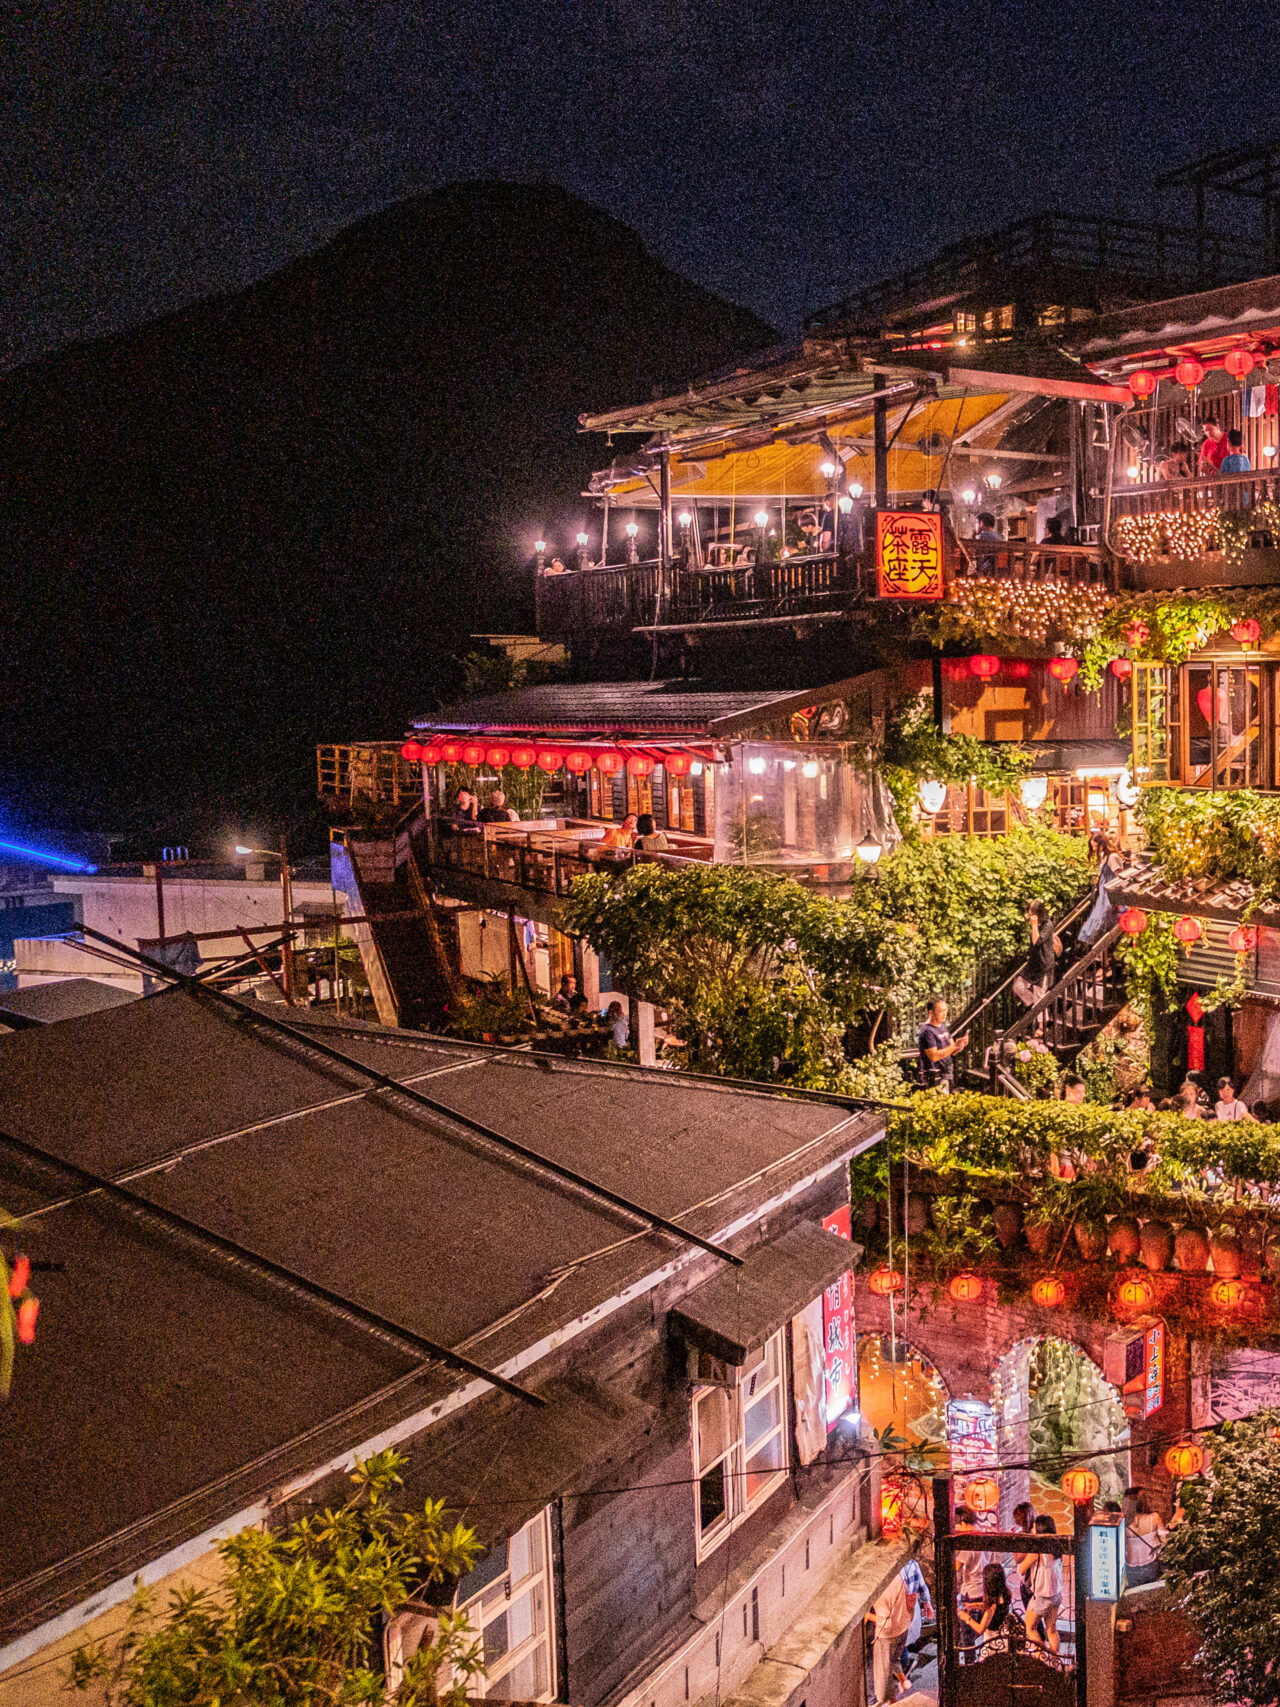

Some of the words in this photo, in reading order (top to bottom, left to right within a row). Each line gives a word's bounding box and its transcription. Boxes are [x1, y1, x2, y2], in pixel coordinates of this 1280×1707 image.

[884, 525, 910, 582] 茶座
[909, 528, 937, 582] 露天
[827, 1224, 844, 1396] 情城市
